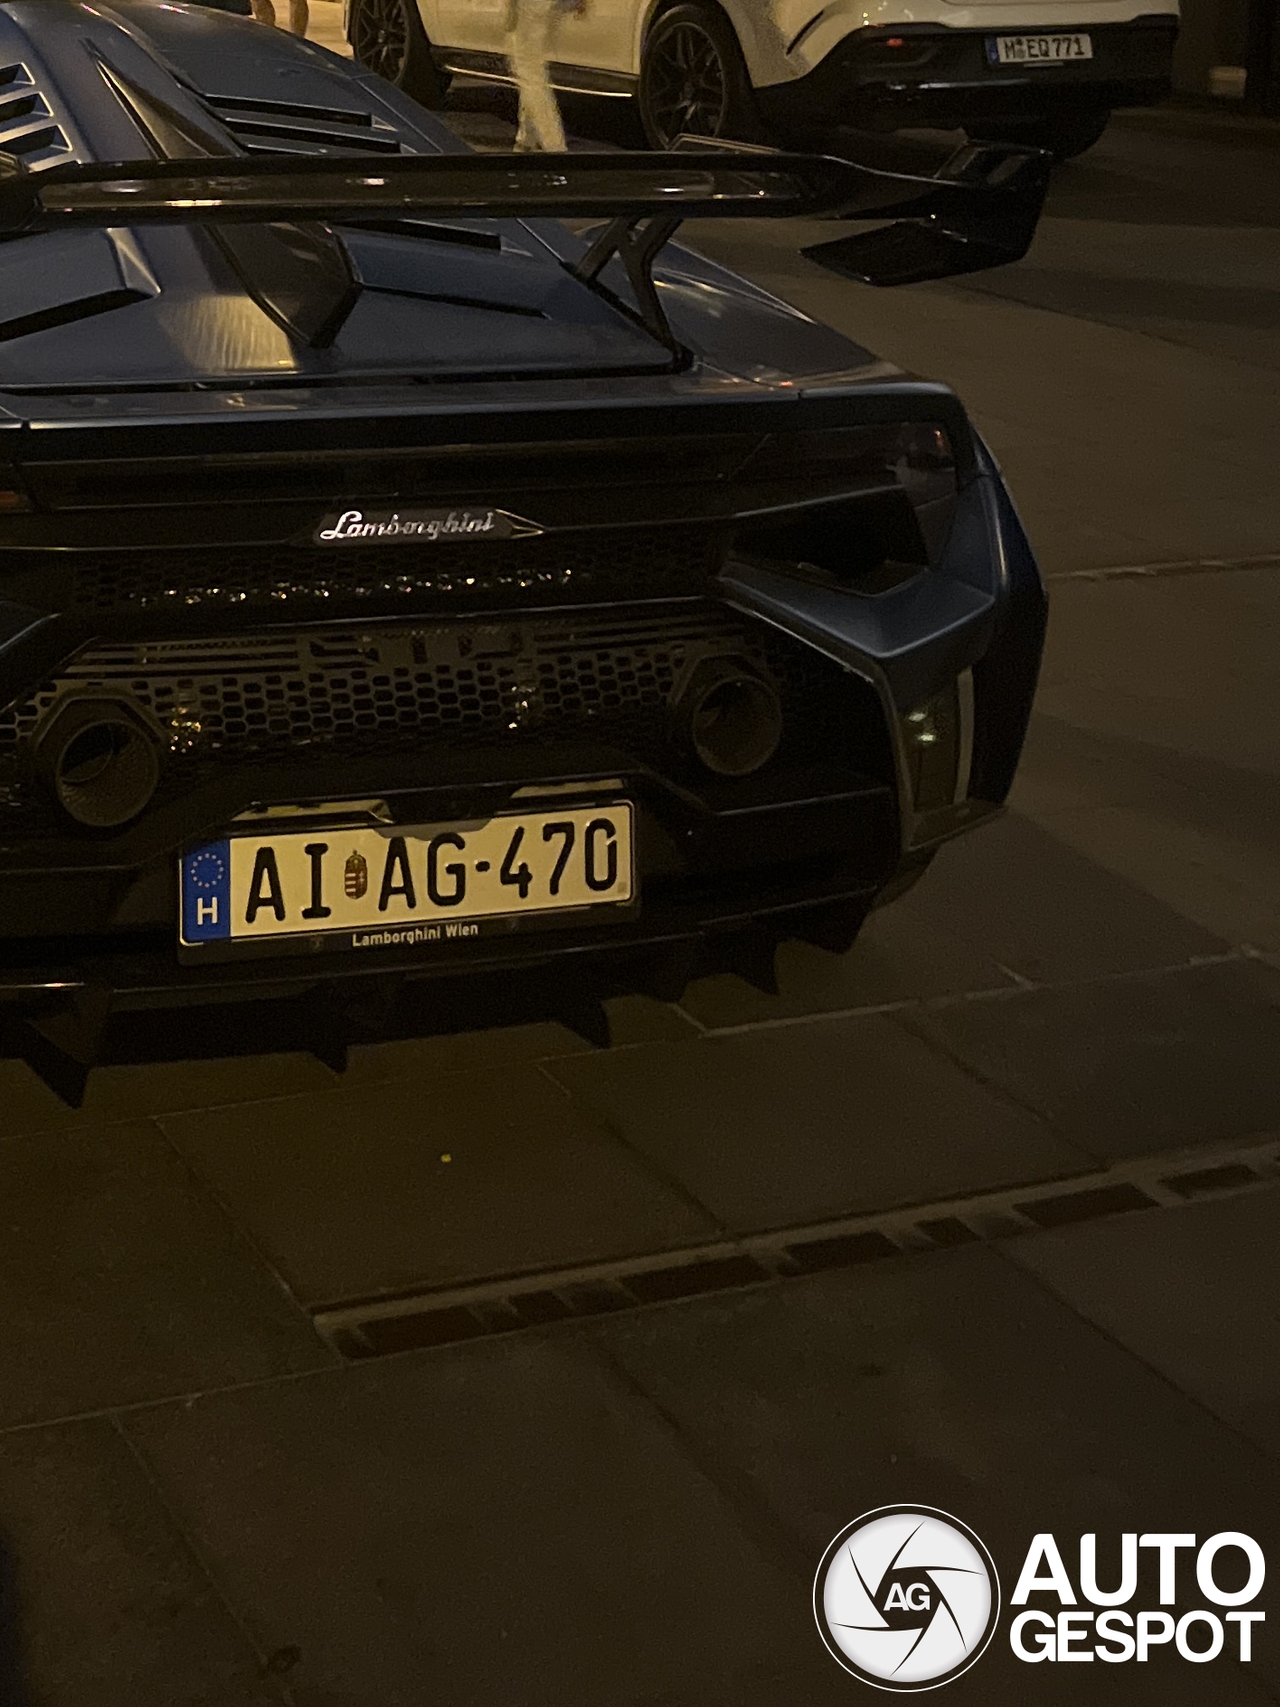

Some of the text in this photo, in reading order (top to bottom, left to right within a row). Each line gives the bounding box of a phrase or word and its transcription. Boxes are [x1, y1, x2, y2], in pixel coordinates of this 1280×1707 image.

[319, 509, 496, 540] Lamborghini
[244, 817, 618, 924] AI AG-470
[196, 897, 219, 926] H
[352, 923, 479, 948] Lamborghini Wien
